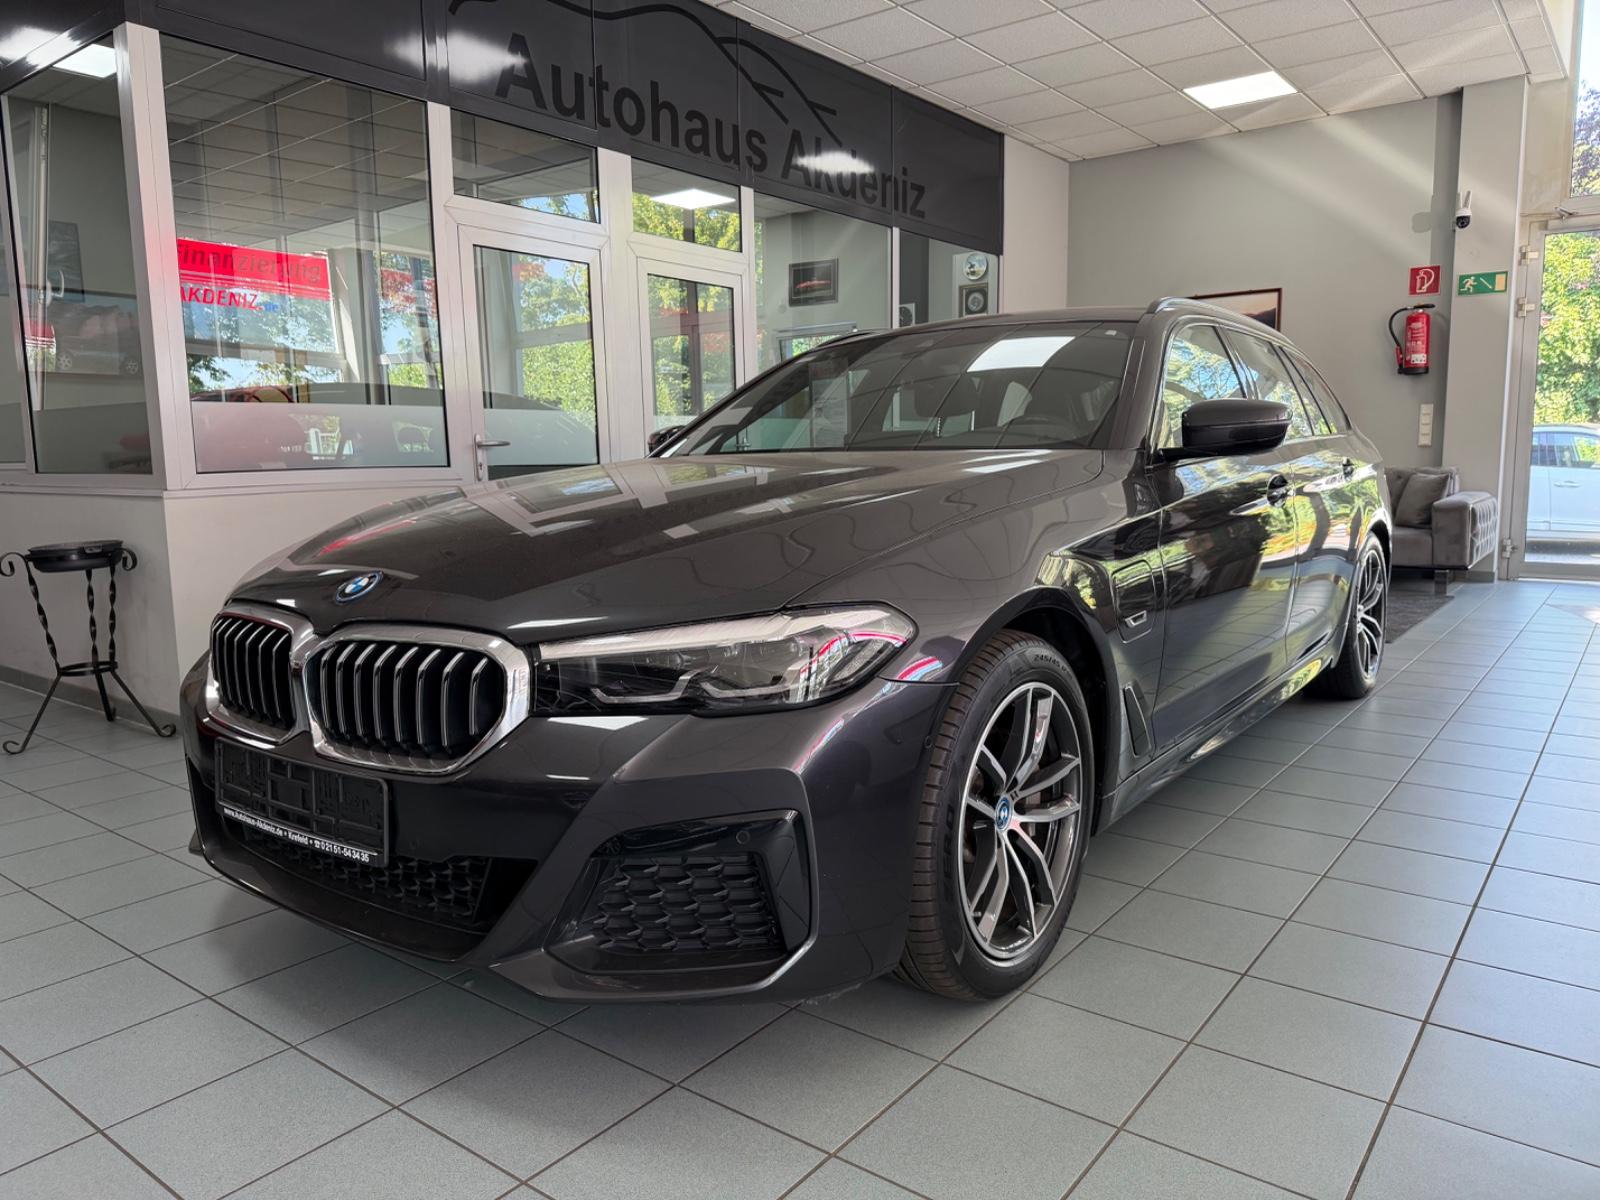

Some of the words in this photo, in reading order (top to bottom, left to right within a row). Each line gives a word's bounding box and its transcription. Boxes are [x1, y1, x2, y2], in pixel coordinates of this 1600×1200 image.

[495, 32, 768, 172] Autohaus
[781, 128, 926, 218] Akdeniz
[288, 831, 308, 845] Krefeld
